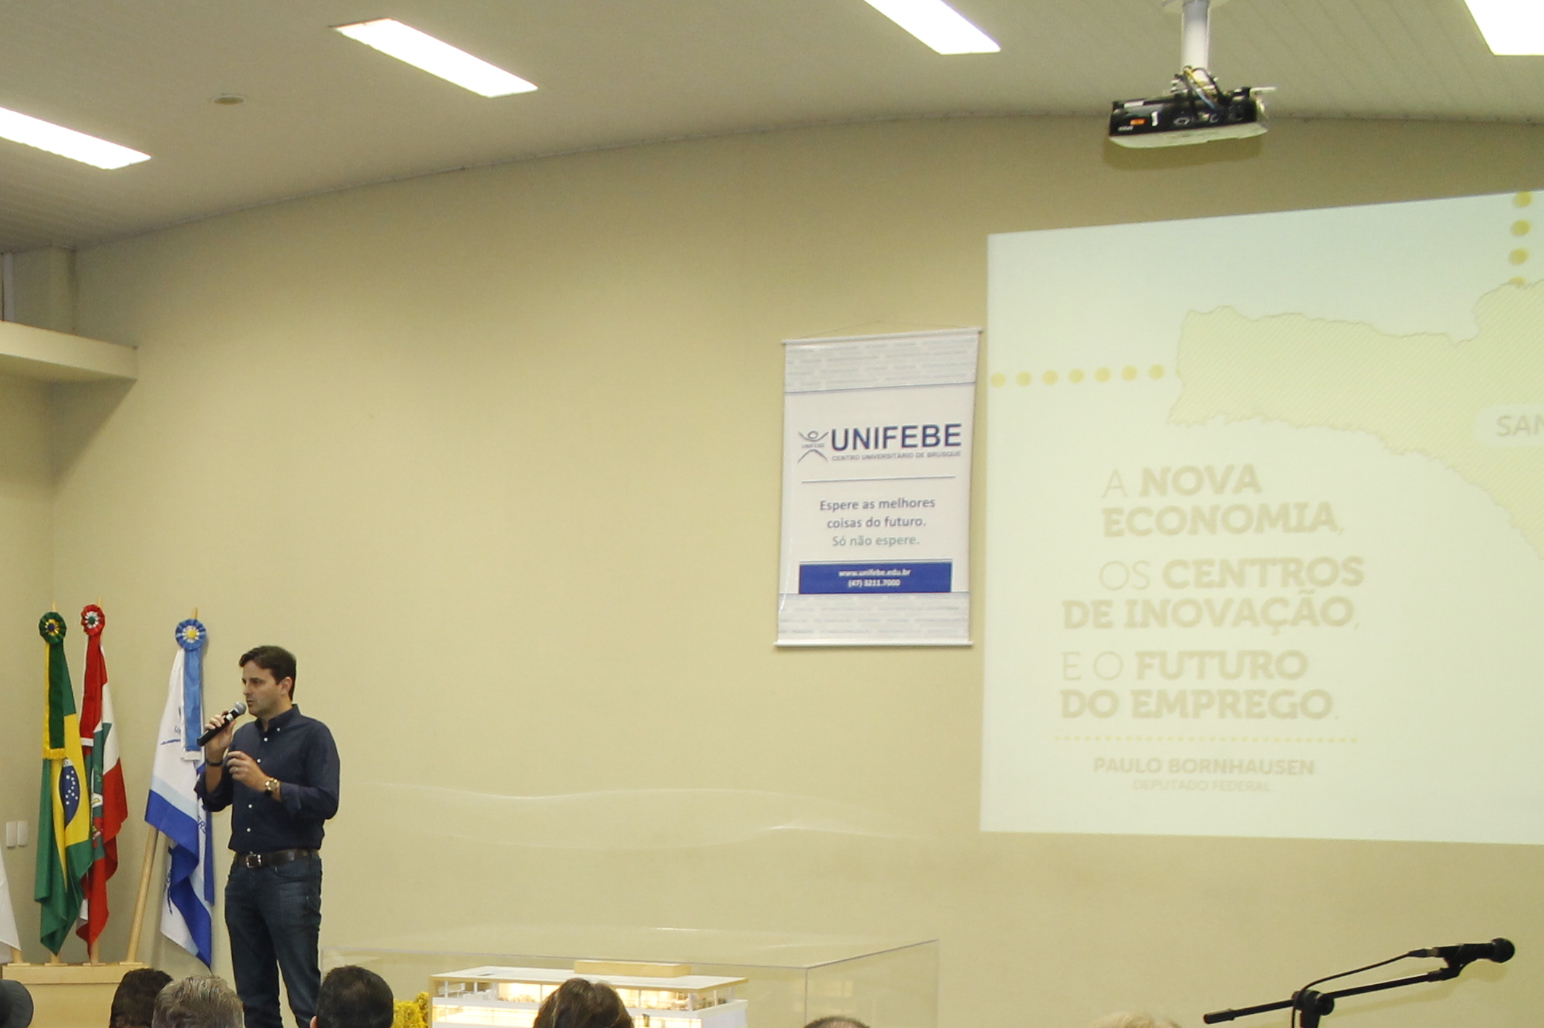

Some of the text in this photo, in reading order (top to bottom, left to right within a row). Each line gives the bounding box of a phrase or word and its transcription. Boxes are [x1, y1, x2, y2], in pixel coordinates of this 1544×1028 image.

[831, 423, 962, 451] UNIFEBE
[1101, 464, 1262, 498] A NOVA
[820, 498, 936, 512] Espere as melhores
[1101, 502, 1346, 537] ECONOMIA,
[827, 516, 926, 529] coisas do futuro.
[832, 535, 920, 547] Só não espere.
[1098, 556, 1365, 591] OS CENTROS
[1062, 590, 1361, 634] DE INOVAÇÃO,
[1062, 650, 1309, 681] E O FUTURO
[1060, 689, 1340, 720] DO EMPREGO.
[1093, 758, 1316, 775] PAULO BORNHAUSEN
[1132, 779, 1271, 793] DEPUTADO FEDERAL
